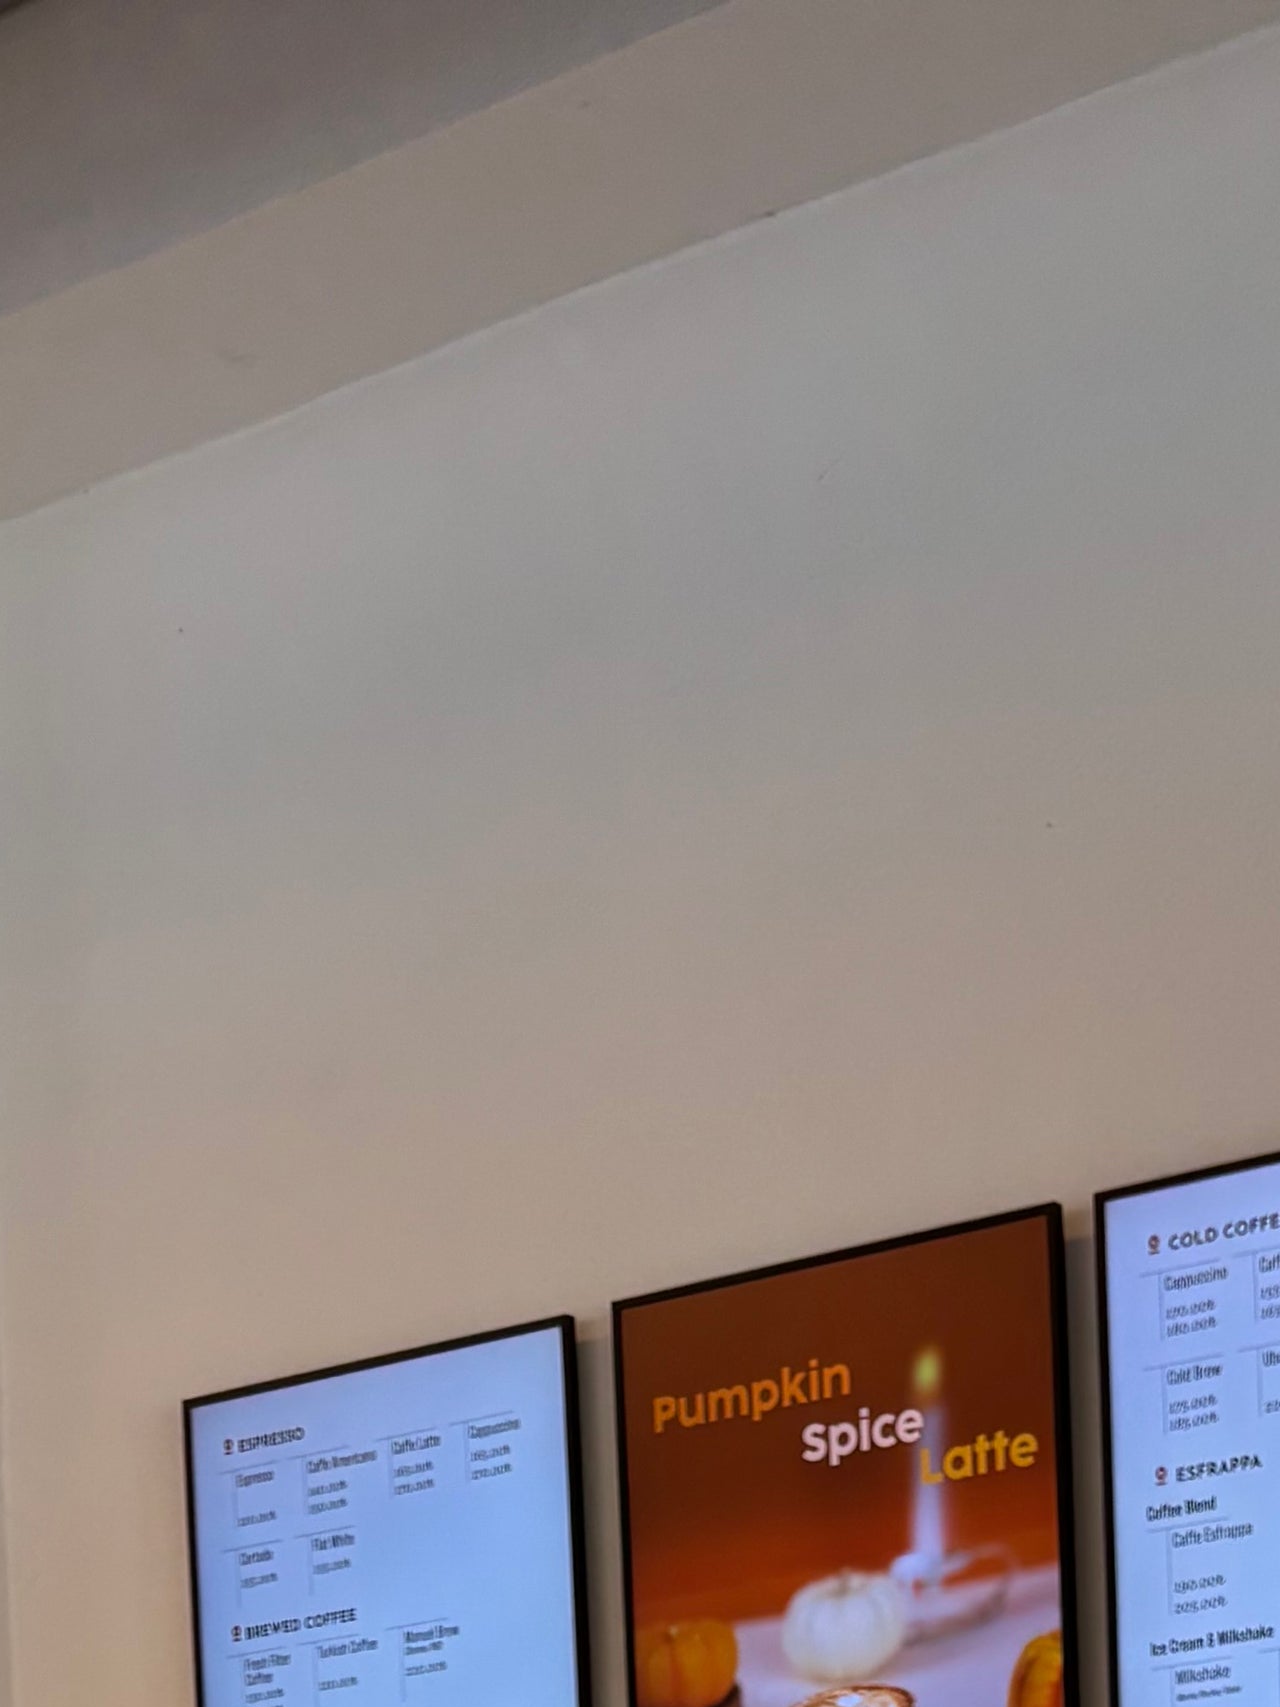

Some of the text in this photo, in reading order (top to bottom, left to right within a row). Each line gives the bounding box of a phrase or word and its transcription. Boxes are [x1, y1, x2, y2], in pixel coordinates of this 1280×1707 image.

[1168, 1226, 1218, 1252] COLD
[652, 1357, 851, 1434] Pumpkin
[920, 1430, 1040, 1486] Latte
[1175, 1454, 1264, 1483] ESFRAPPA
